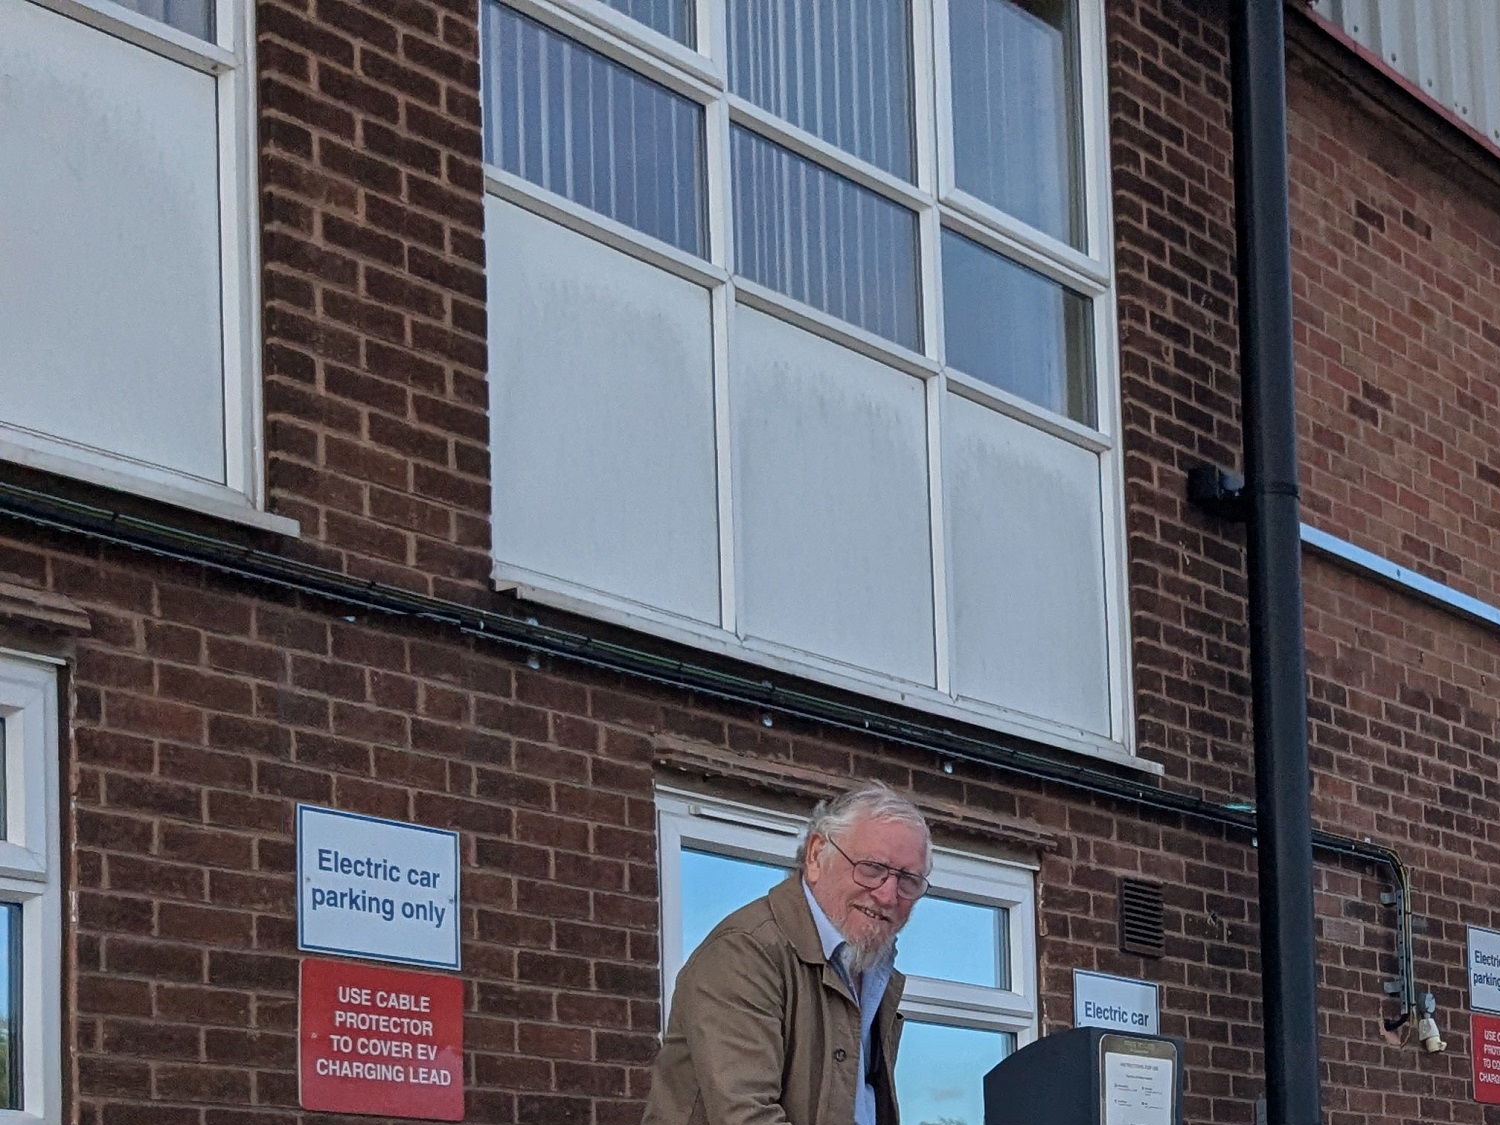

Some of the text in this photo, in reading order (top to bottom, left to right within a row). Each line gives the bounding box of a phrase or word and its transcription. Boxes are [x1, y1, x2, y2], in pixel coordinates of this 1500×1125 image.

[317, 848, 440, 889] Electric car
[311, 886, 446, 928] parking only
[338, 985, 431, 1013] USE CABLE
[334, 1010, 433, 1036] PROTECTOR
[1084, 1000, 1149, 1027] Electric car
[329, 1034, 438, 1061] TO COVER EV
[1485, 1030, 1497, 1040] USE
[316, 1058, 451, 1086] CHARGING LEAD
[1483, 1058, 1491, 1068] TO
